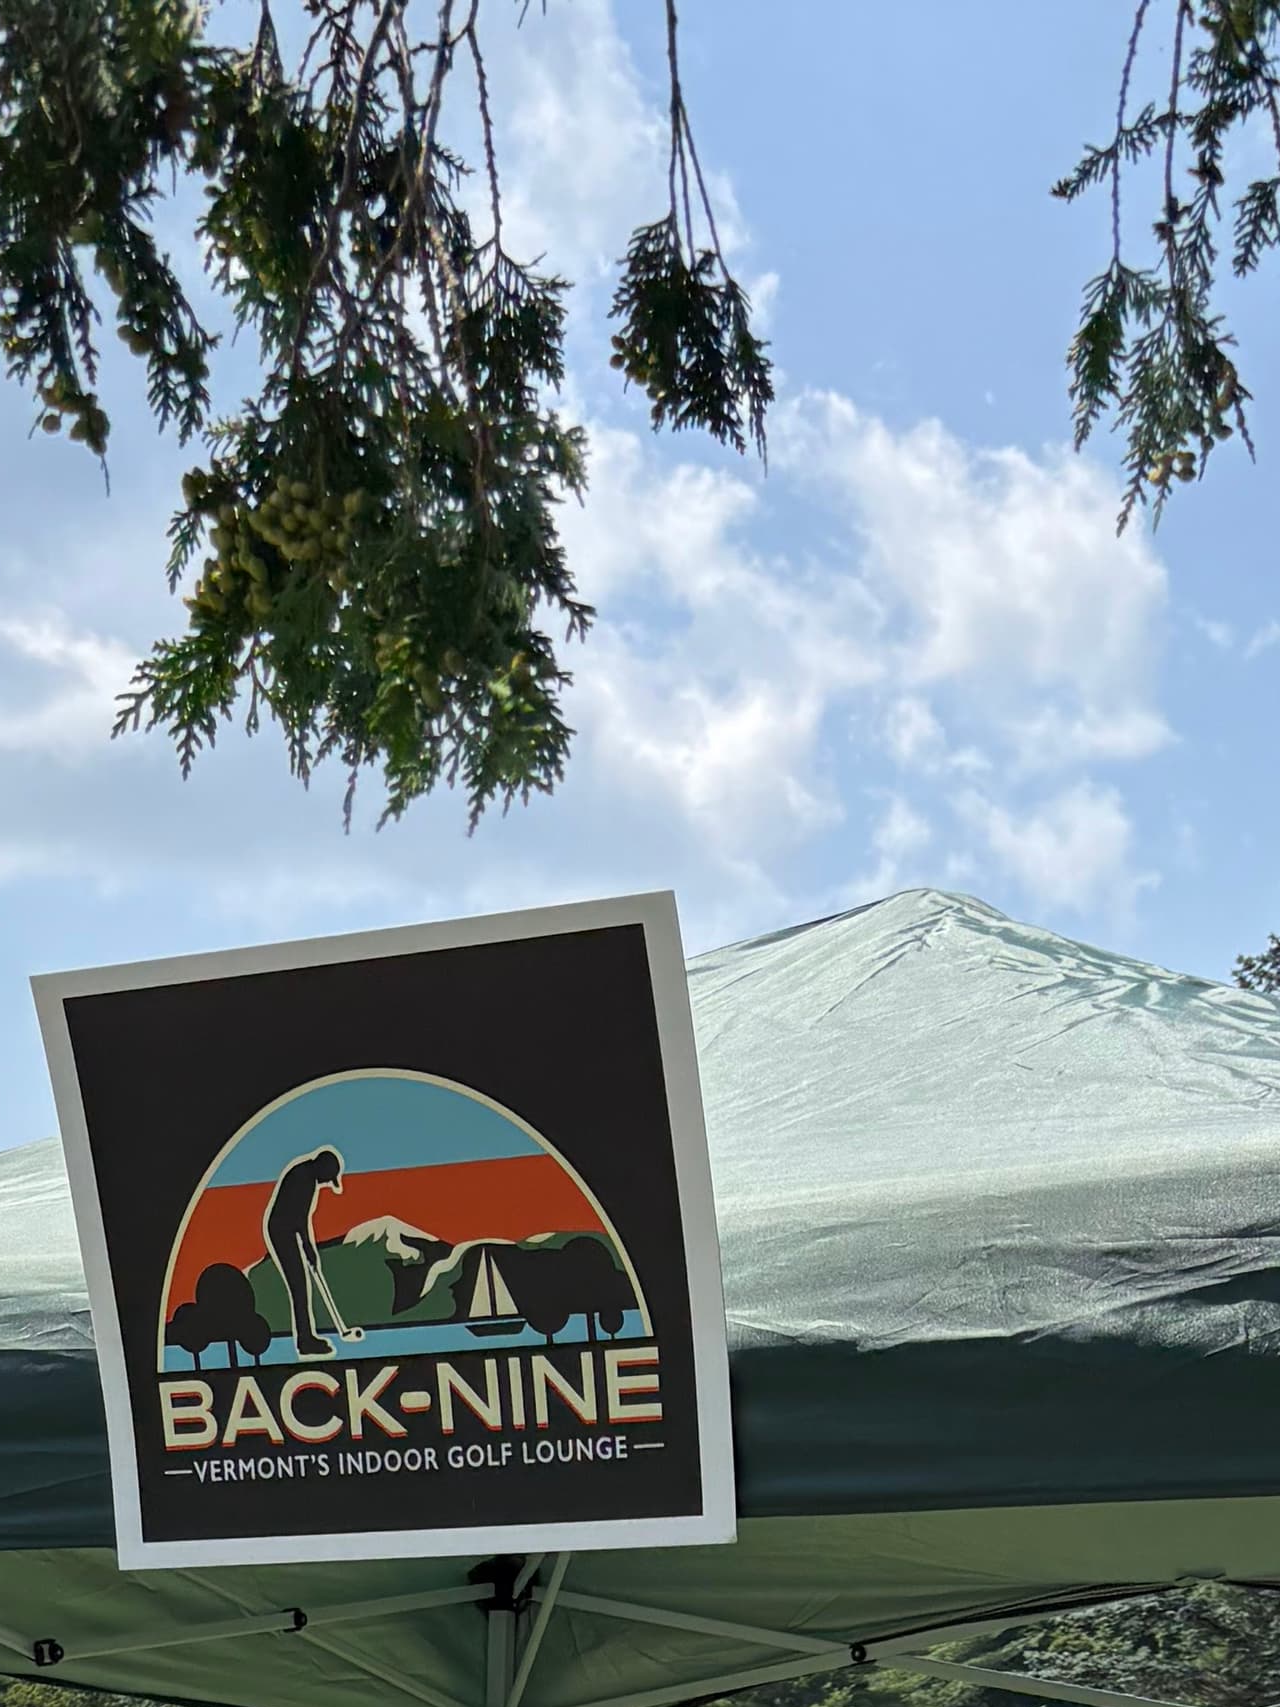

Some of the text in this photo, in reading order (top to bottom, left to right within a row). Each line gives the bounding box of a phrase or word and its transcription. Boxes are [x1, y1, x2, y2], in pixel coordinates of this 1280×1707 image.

[158, 1346, 664, 1452] BACK-NINE
[193, 1435, 630, 1483] VERMONT'S INDOOR GOLF LOUNGE
